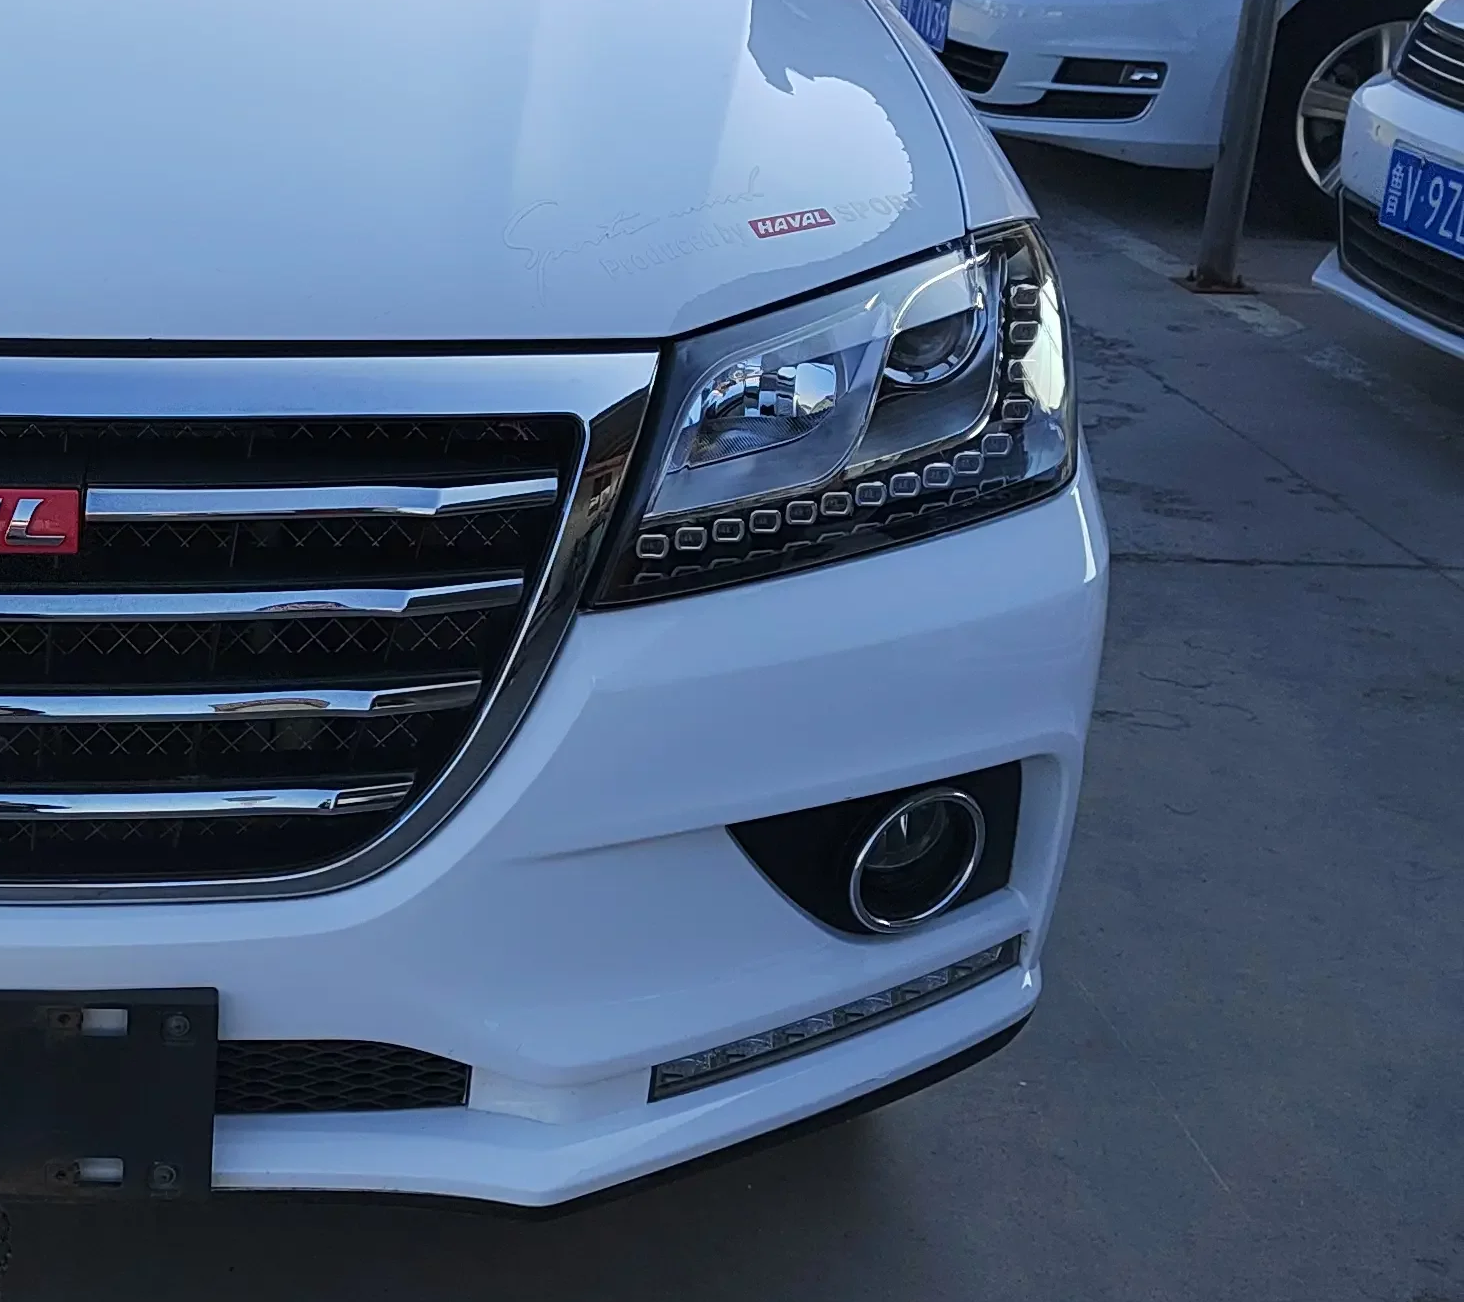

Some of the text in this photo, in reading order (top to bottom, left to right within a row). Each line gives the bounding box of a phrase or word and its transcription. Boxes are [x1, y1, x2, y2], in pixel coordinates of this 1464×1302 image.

[598, 192, 924, 281] Produced by HAVAL SPORT
